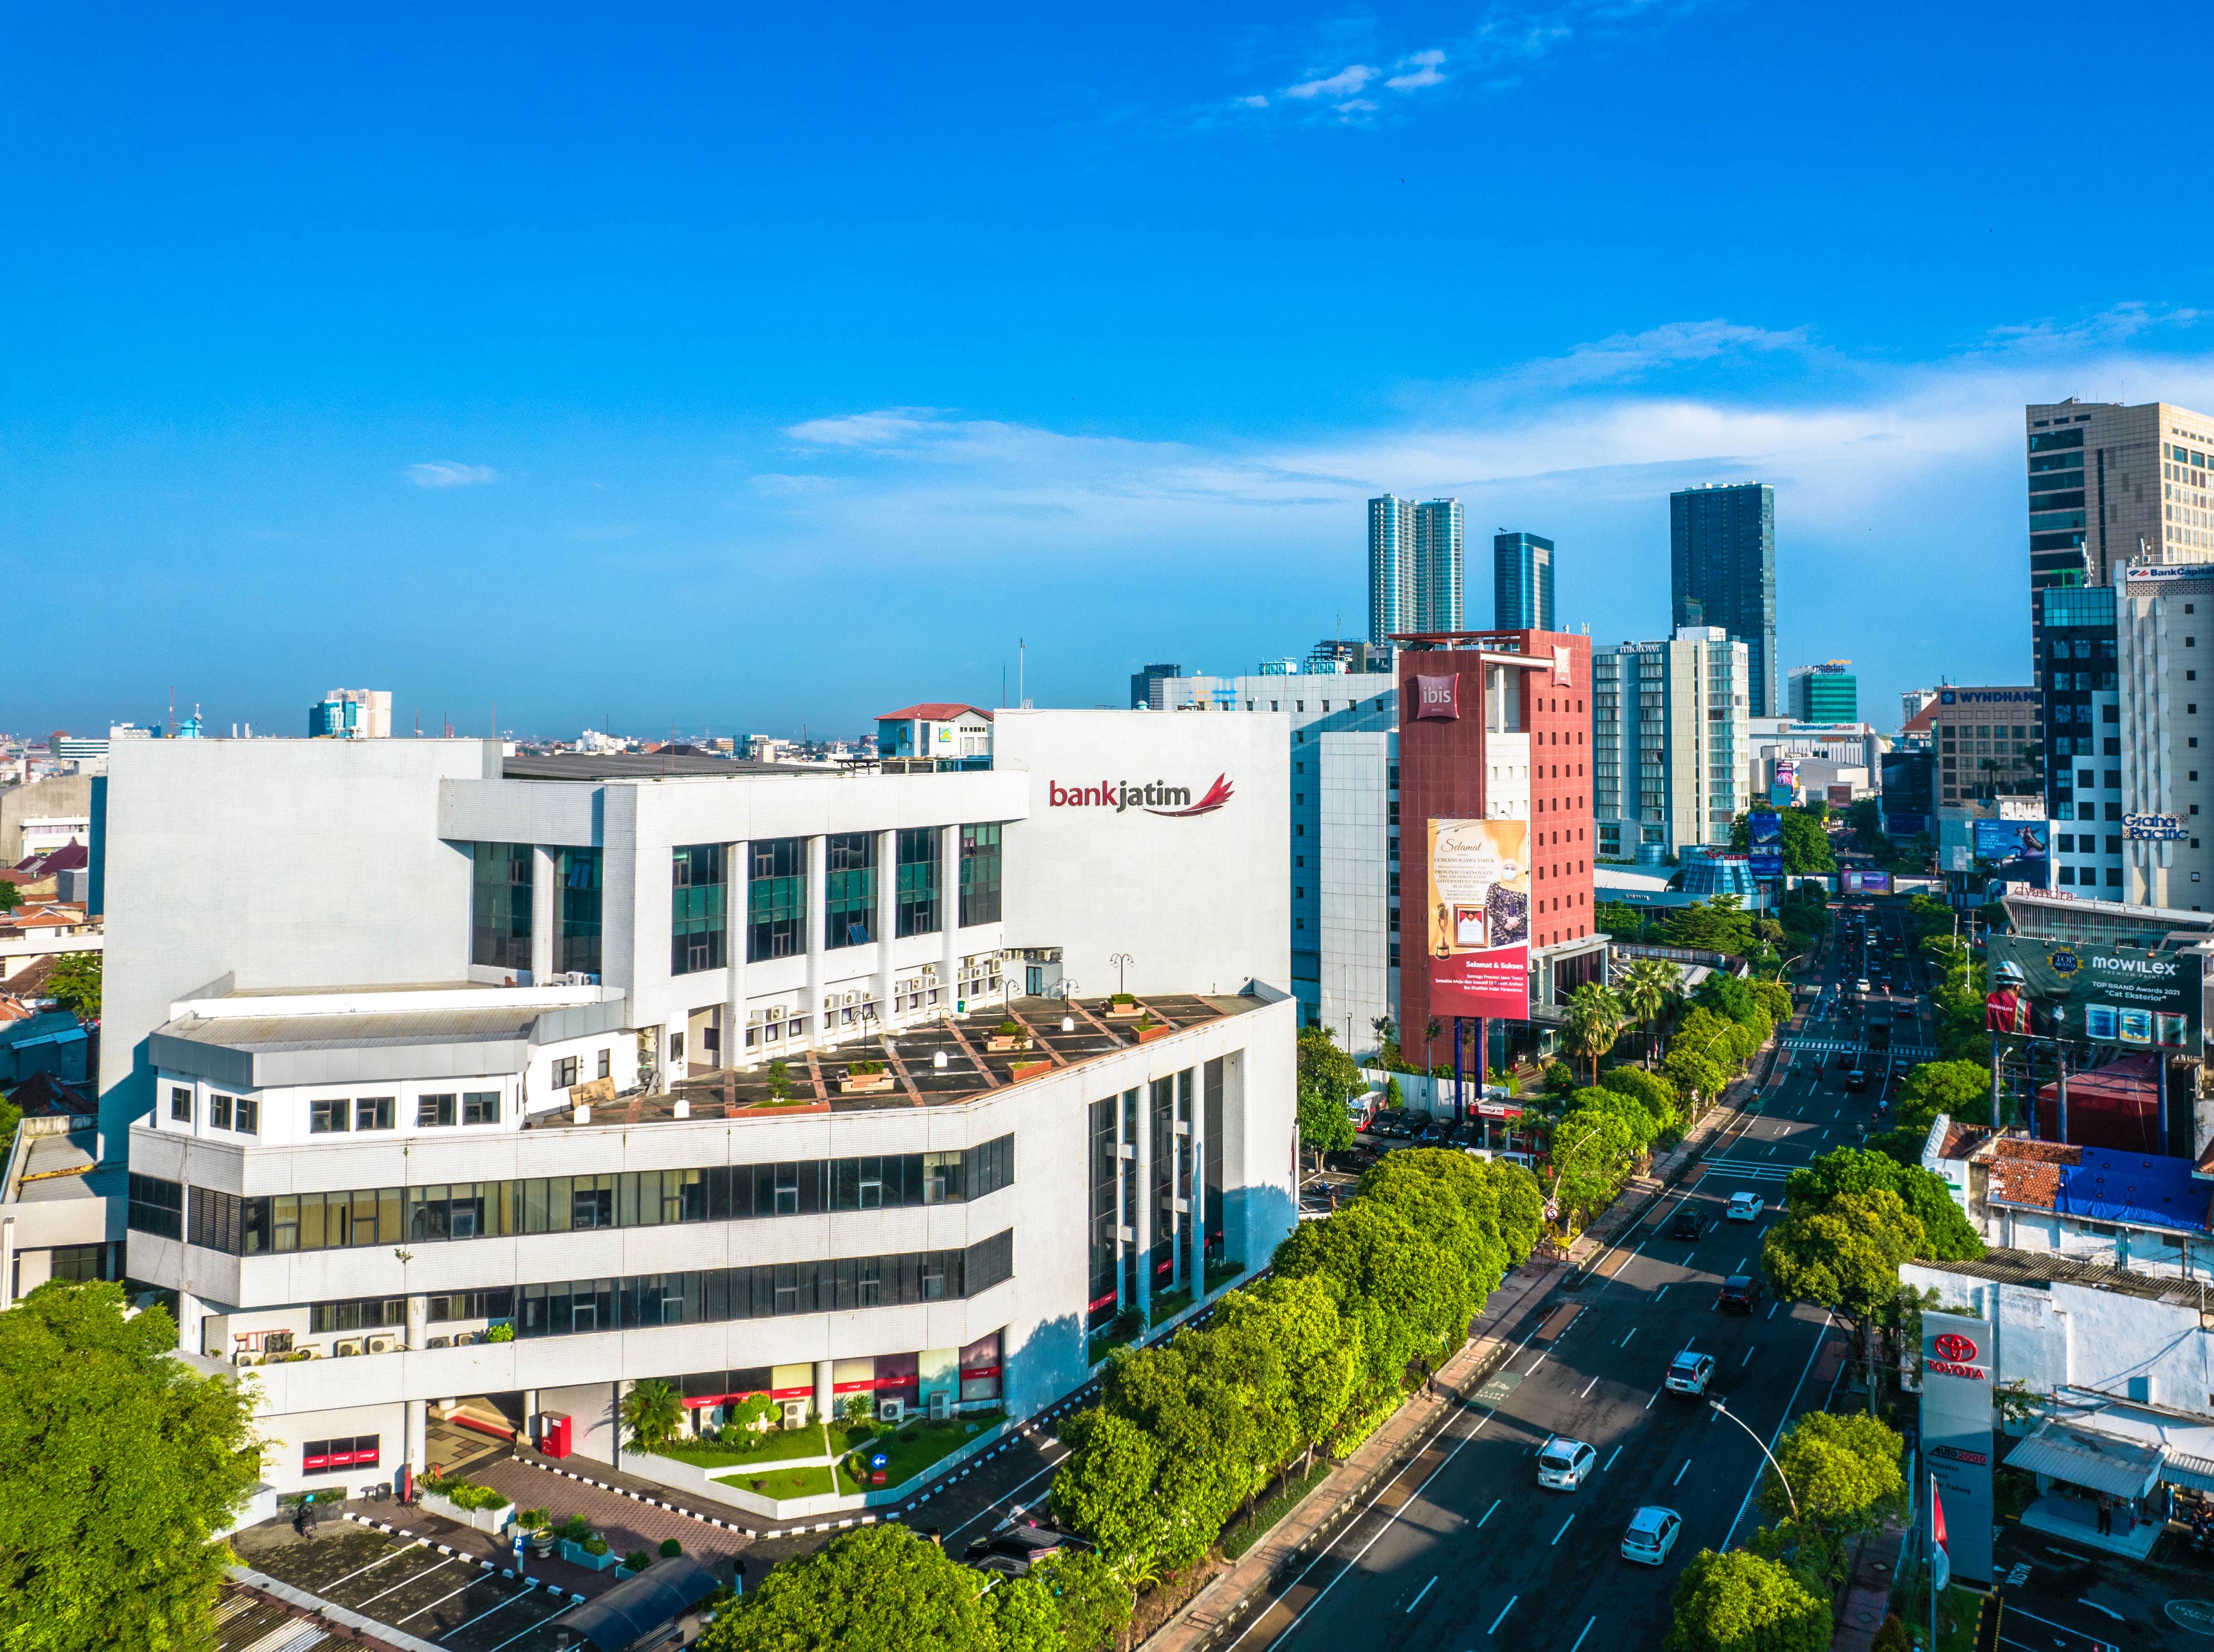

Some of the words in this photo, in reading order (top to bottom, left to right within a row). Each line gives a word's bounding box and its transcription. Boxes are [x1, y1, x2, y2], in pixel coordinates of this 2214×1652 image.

[1620, 643, 1662, 654] midtown
[1423, 686, 1451, 703] ibis
[1960, 691, 2035, 703] WYNDHAM
[1050, 779, 1191, 813] bankjatim
[2123, 813, 2177, 828] Graha
[2130, 827, 2189, 840] Pacific
[1441, 839, 1483, 852] Selamat
[2015, 881, 2074, 901] dyandra
[2055, 955, 2075, 963] TOP
[1927, 1360, 1986, 1380] TOYOTA
[1927, 1469, 1948, 1479] Srvis
[515, 1538, 522, 1549] P
